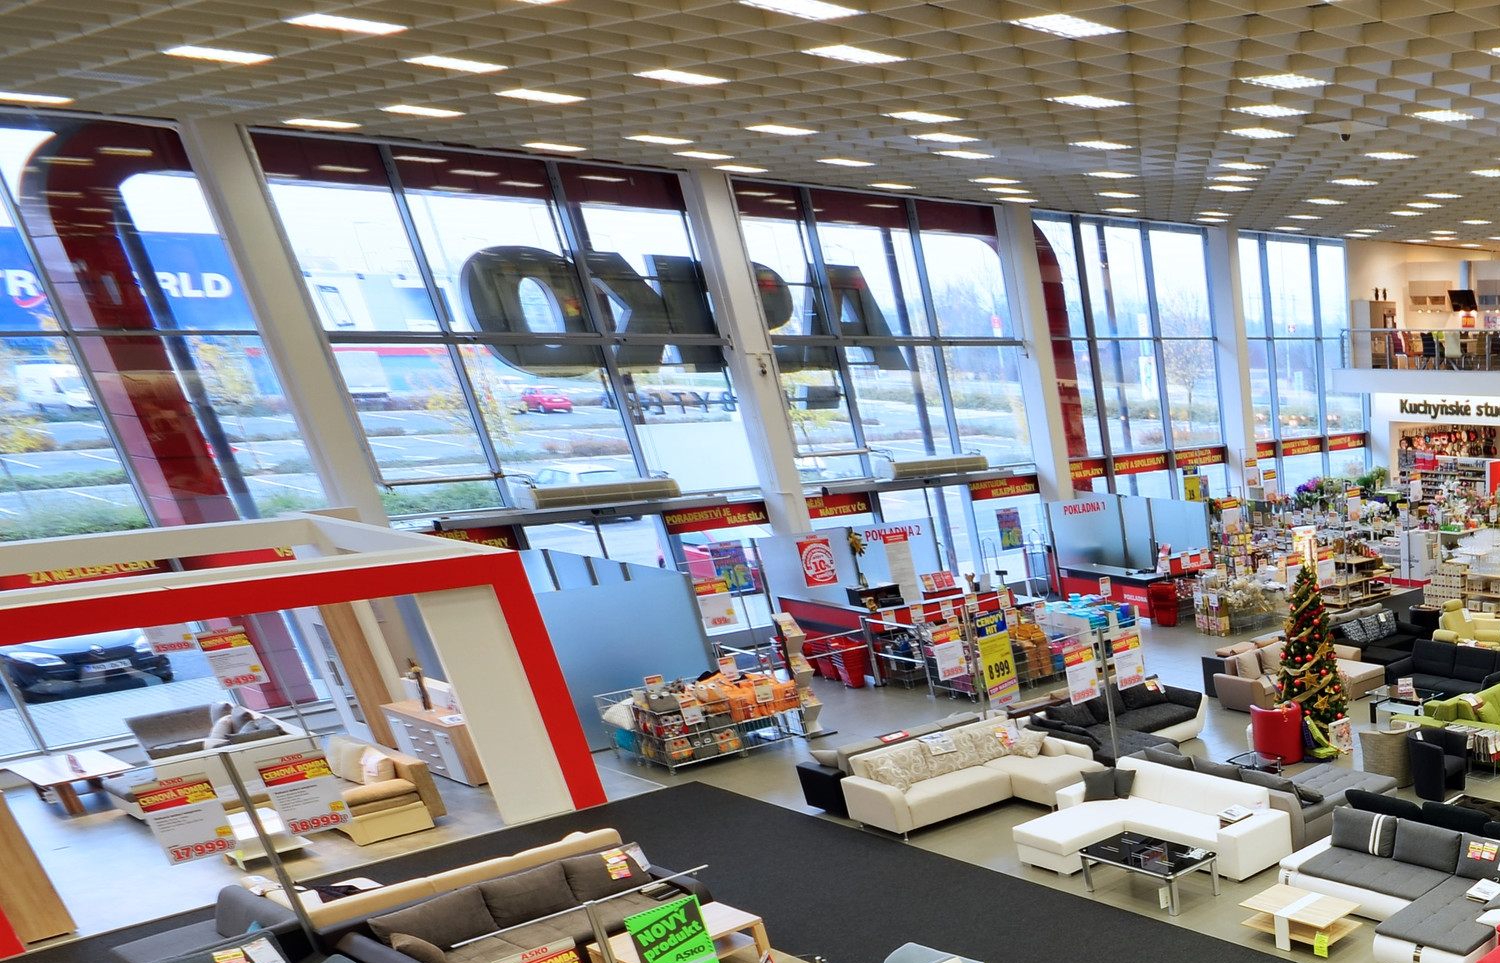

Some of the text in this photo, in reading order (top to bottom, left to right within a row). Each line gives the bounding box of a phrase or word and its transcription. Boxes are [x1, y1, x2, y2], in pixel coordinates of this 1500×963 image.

[1400, 399, 1471, 419] Kuchyňské
[665, 506, 732, 526] PORADENSTVÍ JE
[1063, 502, 1106, 516] POKLADNA 1
[727, 510, 766, 525] NAŠE SÍLA
[915, 525, 922, 536] 2
[976, 613, 1004, 628] CENOVÝ
[985, 624, 998, 635] HIT
[280, 754, 303, 764] ASKO
[262, 758, 327, 781] CENOVÁ BOMBA
[158, 777, 183, 788] ASKO
[139, 782, 212, 807] CENOVÁ BOMBA
[636, 907, 690, 948] NOVÝ
[643, 921, 703, 963] produkt
[521, 946, 549, 961] ASKO
[674, 944, 706, 962] ASKO
